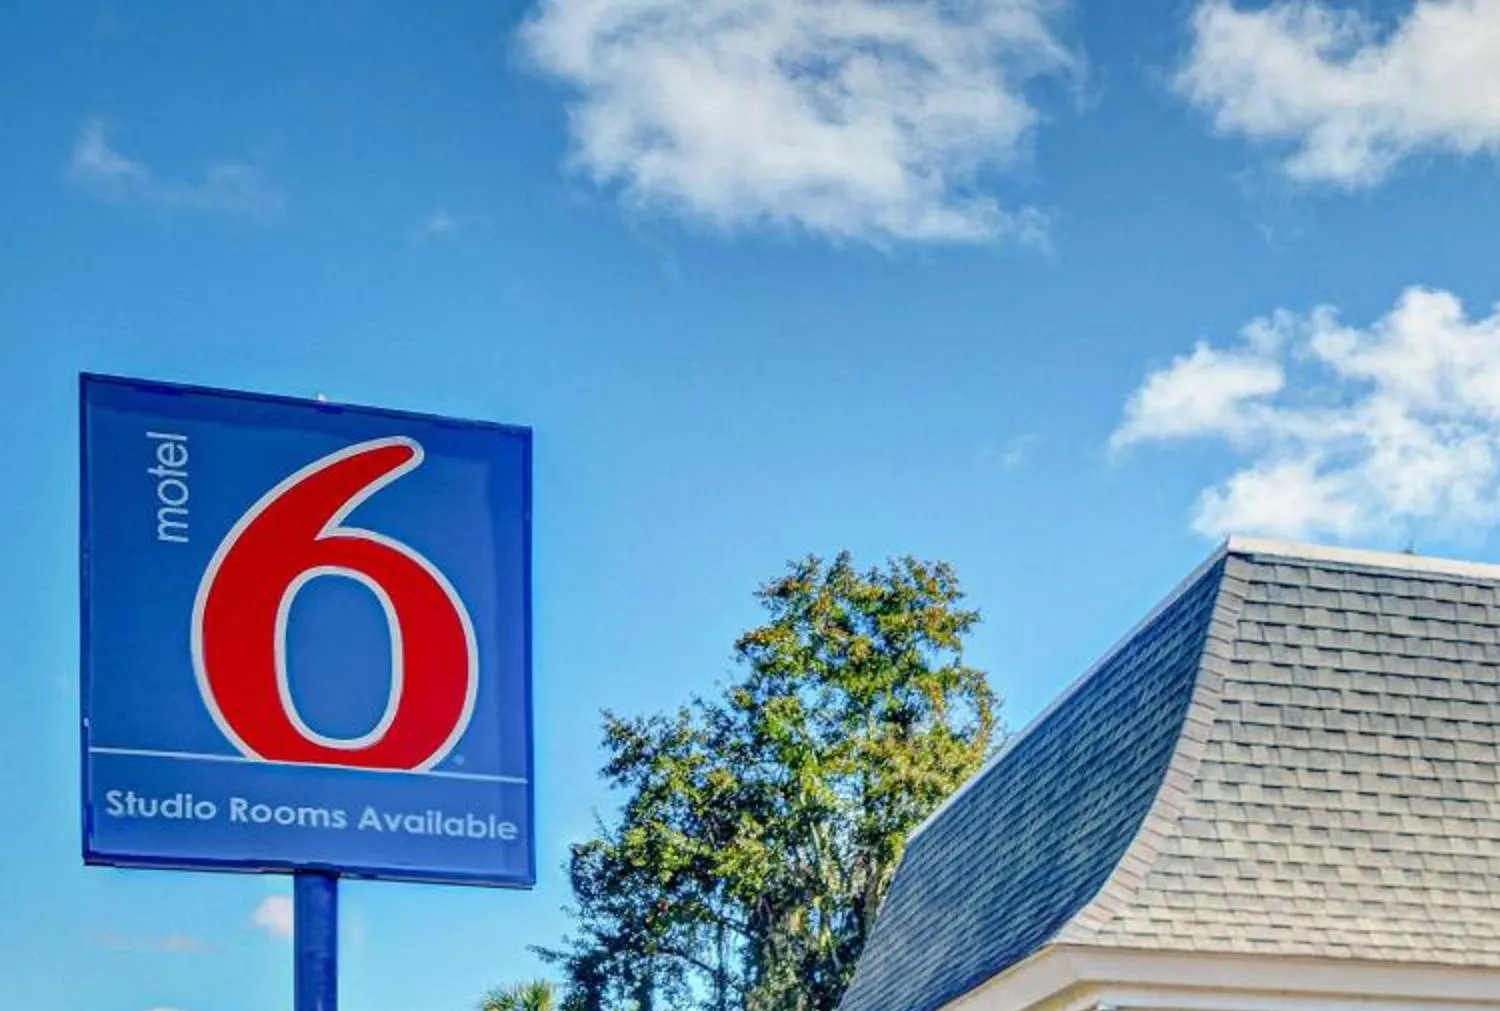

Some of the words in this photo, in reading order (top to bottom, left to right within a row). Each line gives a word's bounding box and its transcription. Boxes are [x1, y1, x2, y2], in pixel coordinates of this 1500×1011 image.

[146, 431, 189, 542] motel
[191, 435, 479, 772] 6
[105, 789, 217, 821] Studio
[229, 797, 347, 829] Rooms
[357, 805, 519, 840] Available
